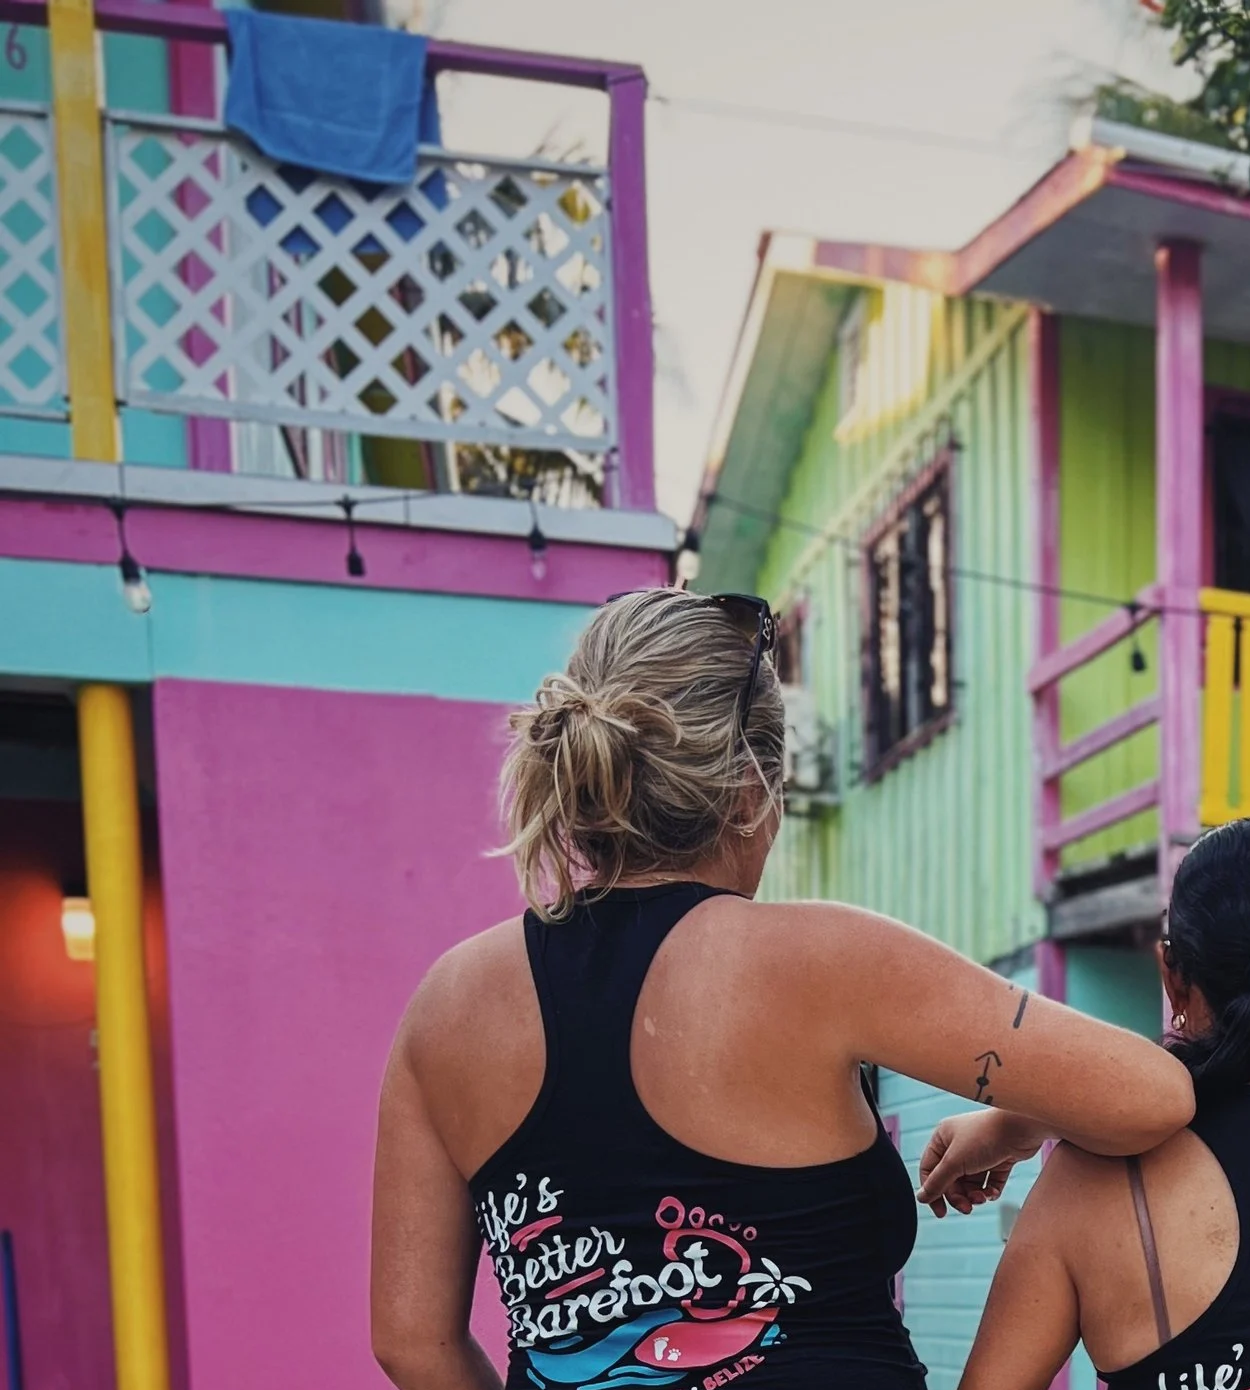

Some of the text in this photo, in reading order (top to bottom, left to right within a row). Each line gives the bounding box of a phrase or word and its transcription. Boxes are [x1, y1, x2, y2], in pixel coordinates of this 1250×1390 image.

[475, 1172, 564, 1254] ife's
[495, 1225, 625, 1307] Better
[506, 1241, 722, 1348] Barefoot
